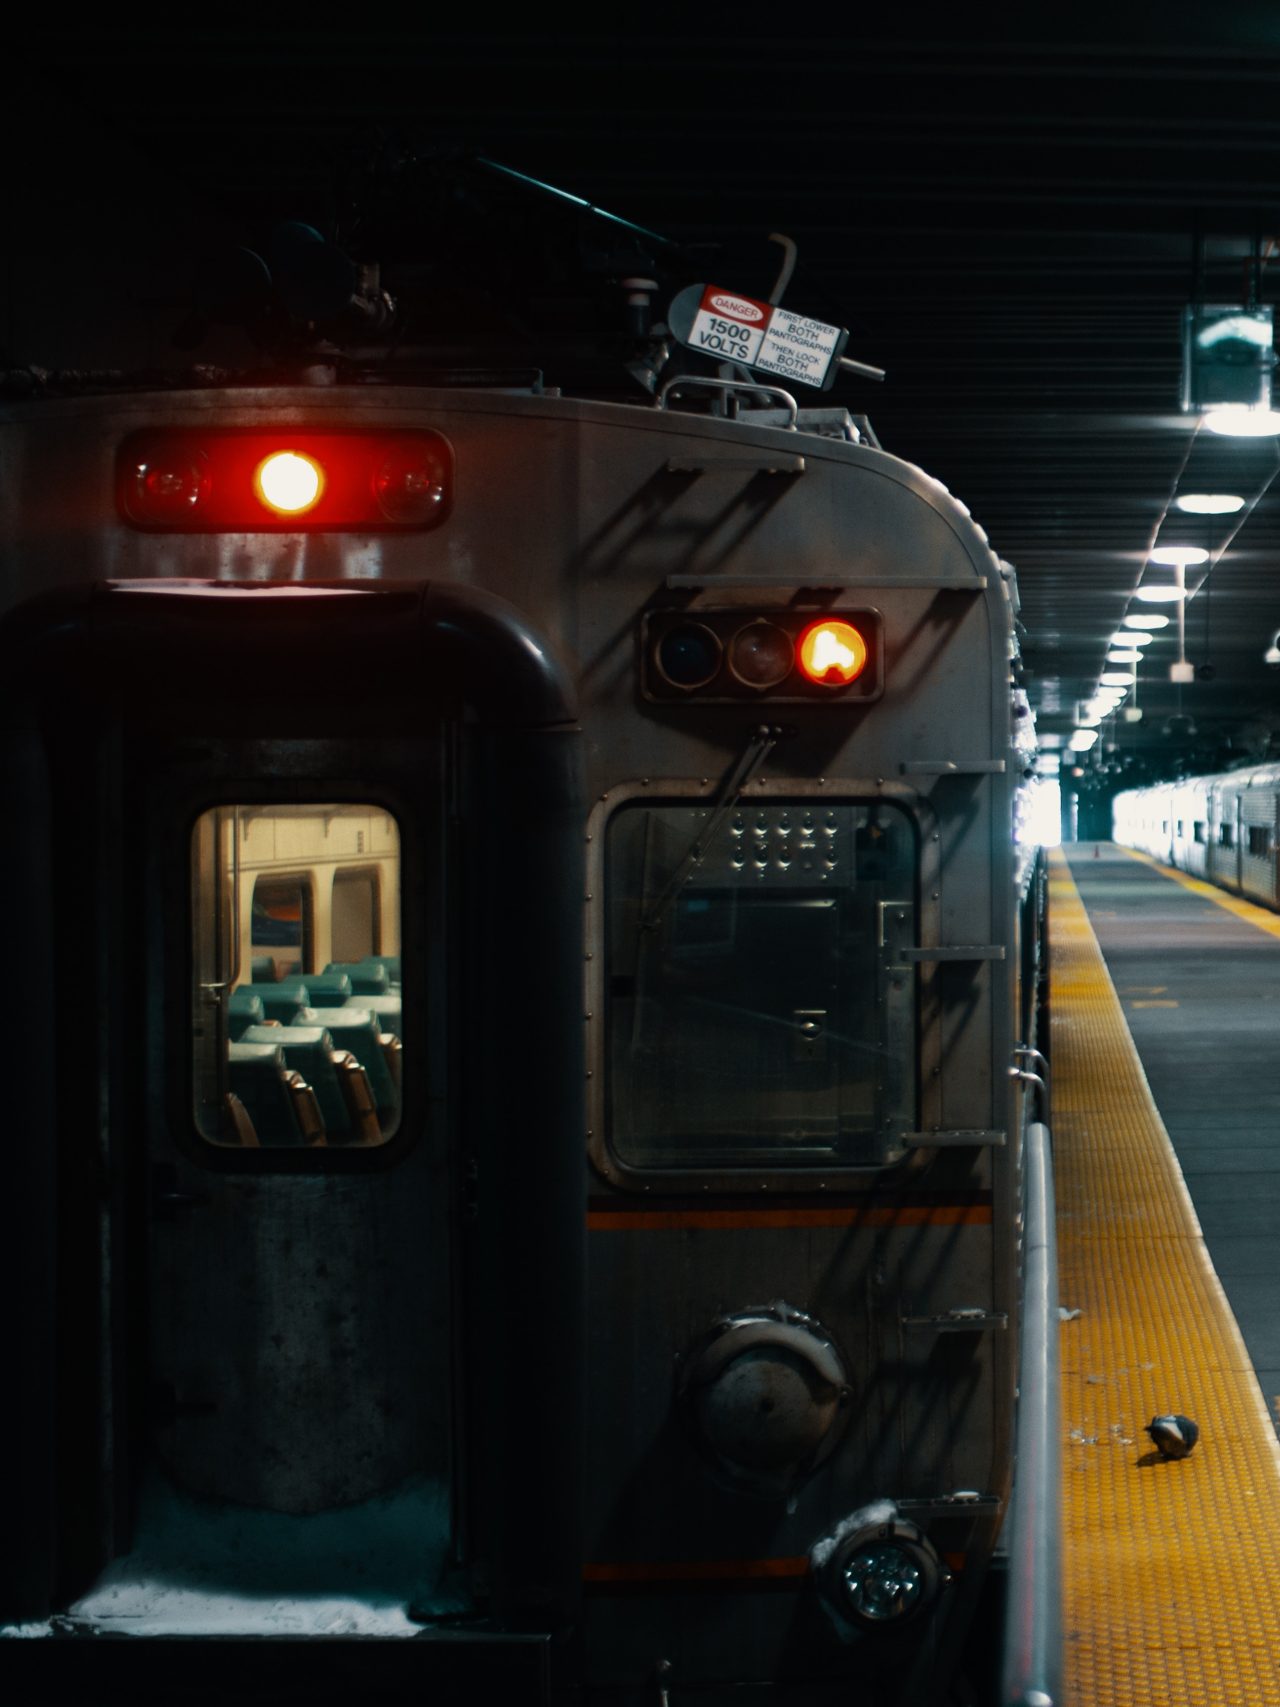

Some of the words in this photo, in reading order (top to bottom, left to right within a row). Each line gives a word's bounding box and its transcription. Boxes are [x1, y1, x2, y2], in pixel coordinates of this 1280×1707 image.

[715, 297, 759, 319] DANGER
[709, 318, 752, 342] 1500
[778, 311, 803, 324] FIRST
[804, 320, 836, 336] LOWER
[787, 323, 820, 341] BOTH
[700, 330, 750, 359] VOLTS
[768, 327, 833, 355] PANTOGRAPHS
[771, 342, 795, 356] THEN
[795, 352, 821, 366] LOCK
[776, 353, 809, 371] BOTH
[757, 358, 822, 385] PANTOGRAPHS
